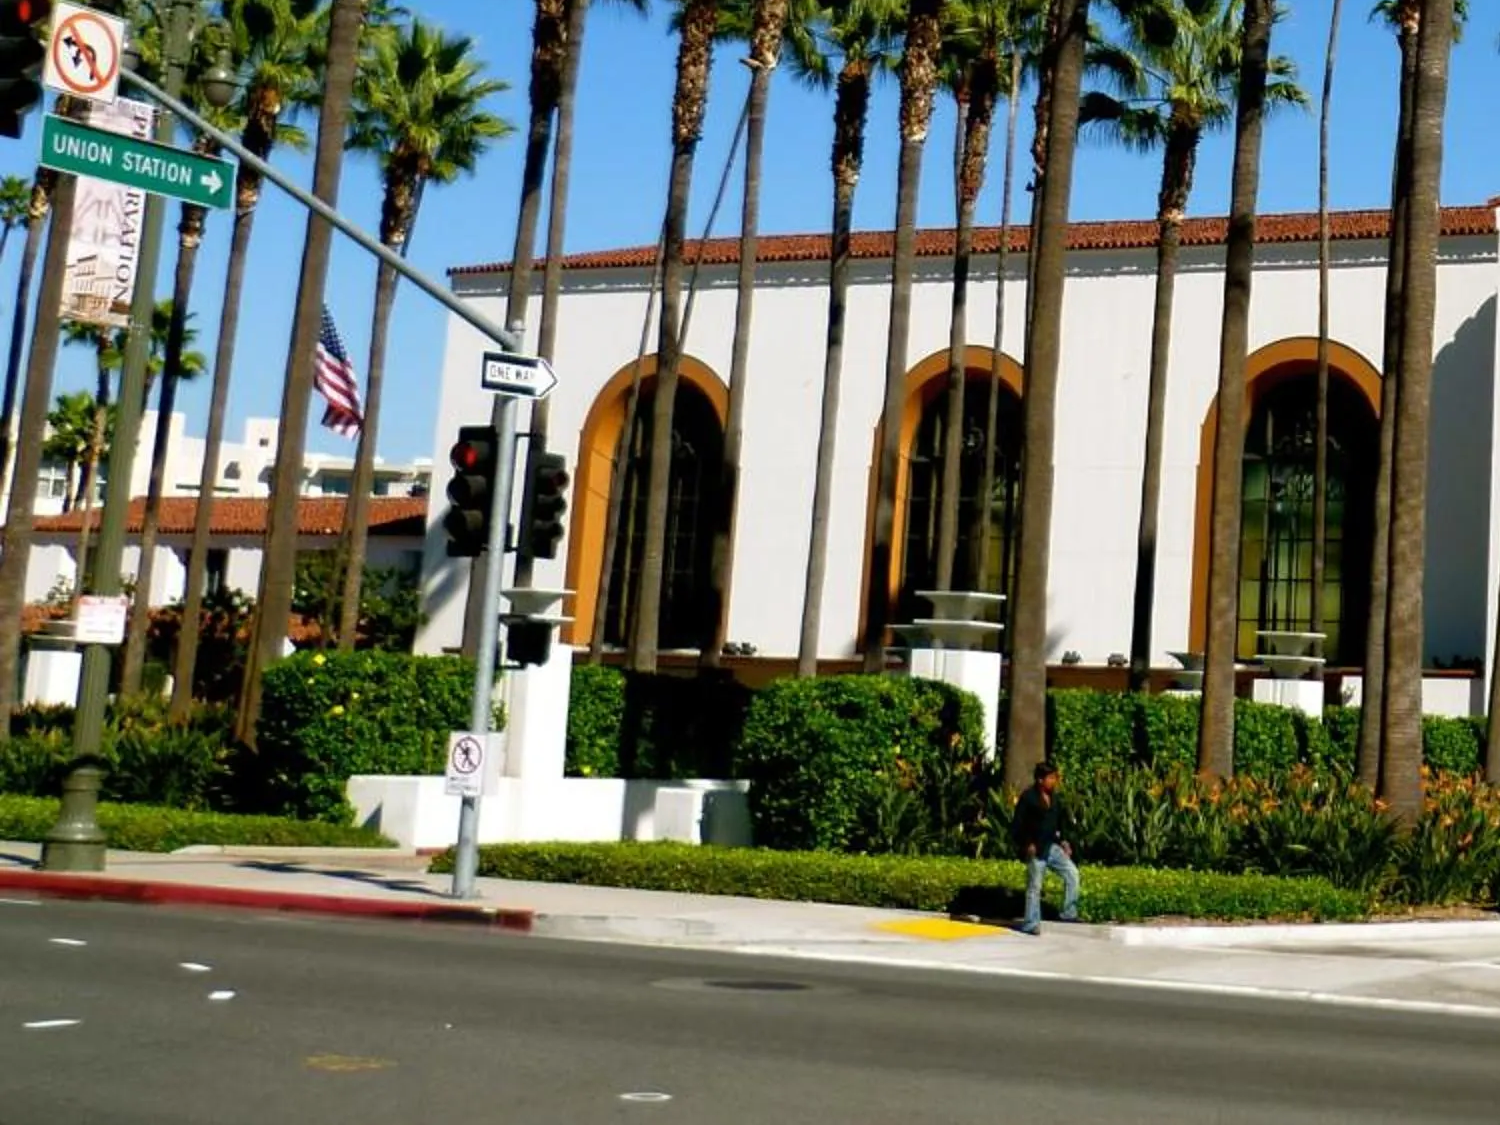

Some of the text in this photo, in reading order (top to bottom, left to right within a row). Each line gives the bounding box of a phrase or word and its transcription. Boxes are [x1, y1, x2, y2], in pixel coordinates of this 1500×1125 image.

[53, 134, 192, 186] UNION STATION
[489, 364, 512, 380] ONE
